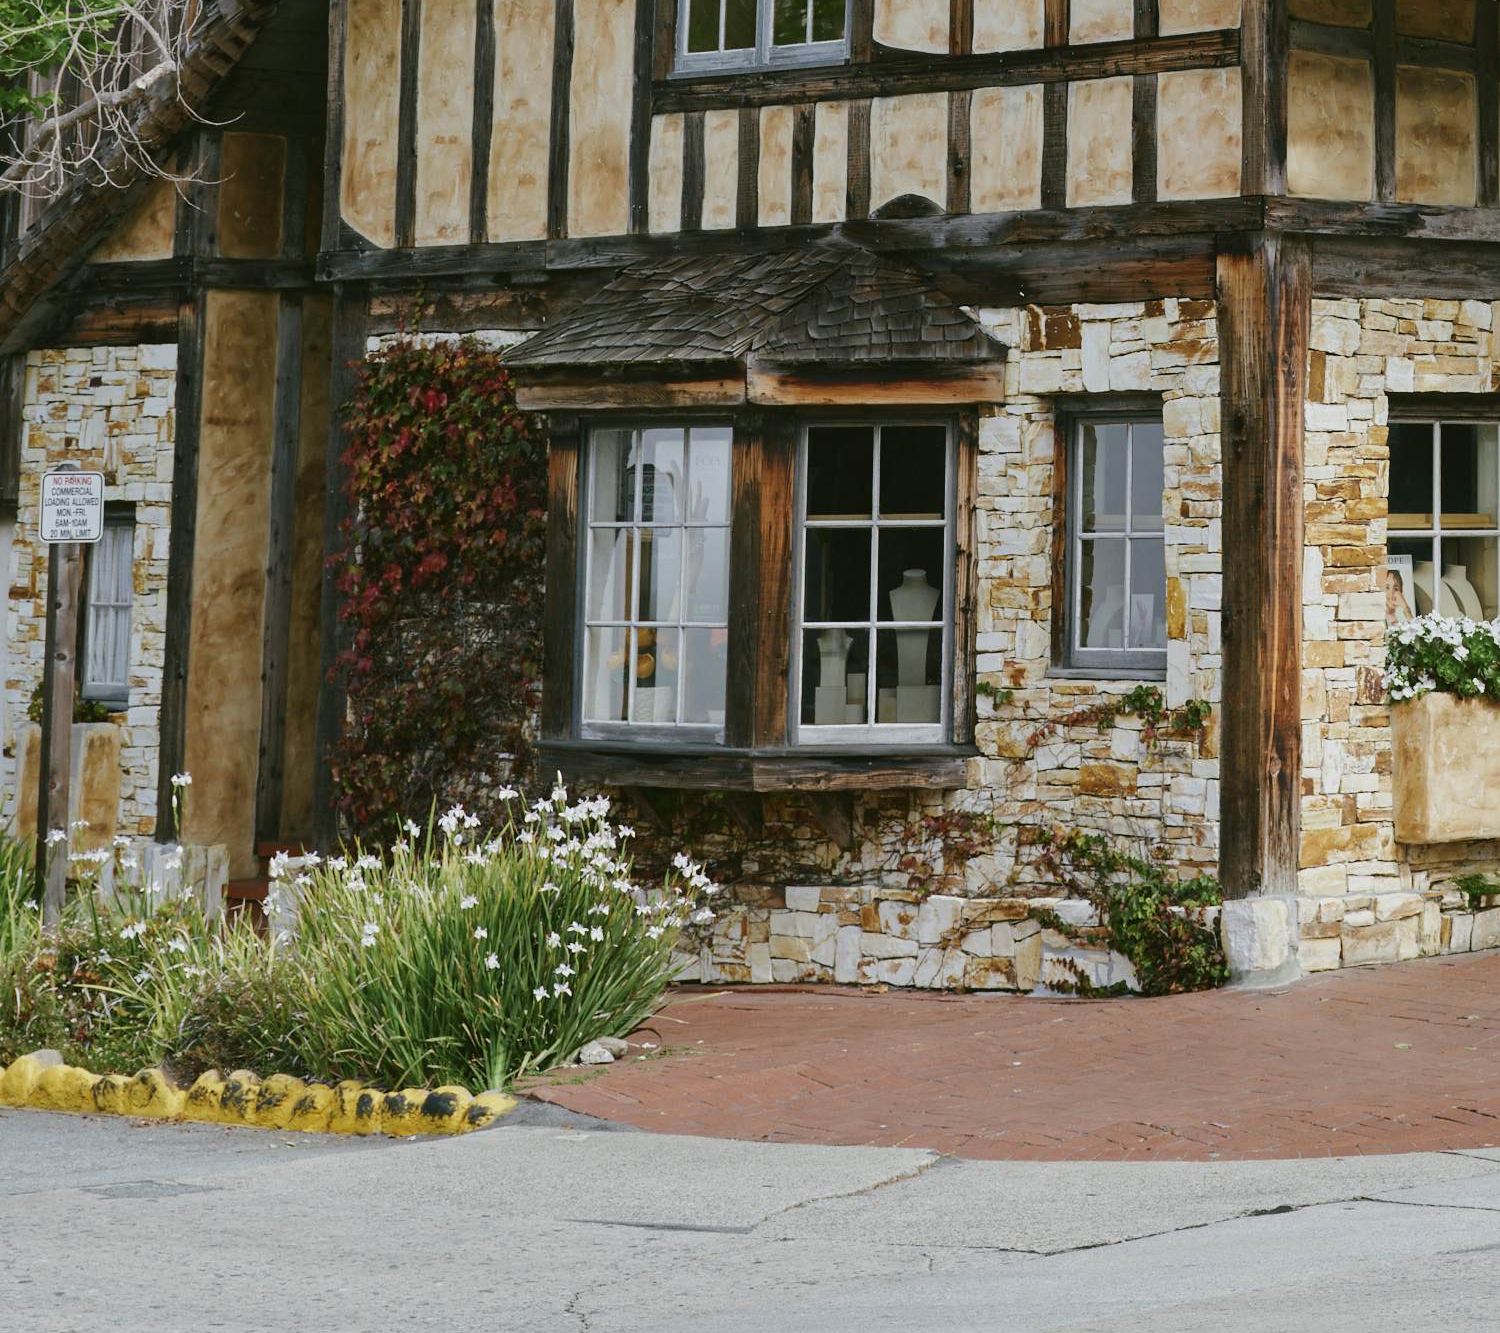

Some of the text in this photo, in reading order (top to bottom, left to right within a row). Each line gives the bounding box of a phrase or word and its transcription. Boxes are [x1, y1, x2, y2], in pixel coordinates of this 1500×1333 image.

[53, 476, 92, 485] NO PARKING
[51, 487, 93, 496] COMMERCIAL
[45, 497, 99, 506] LOADING ALLOWED
